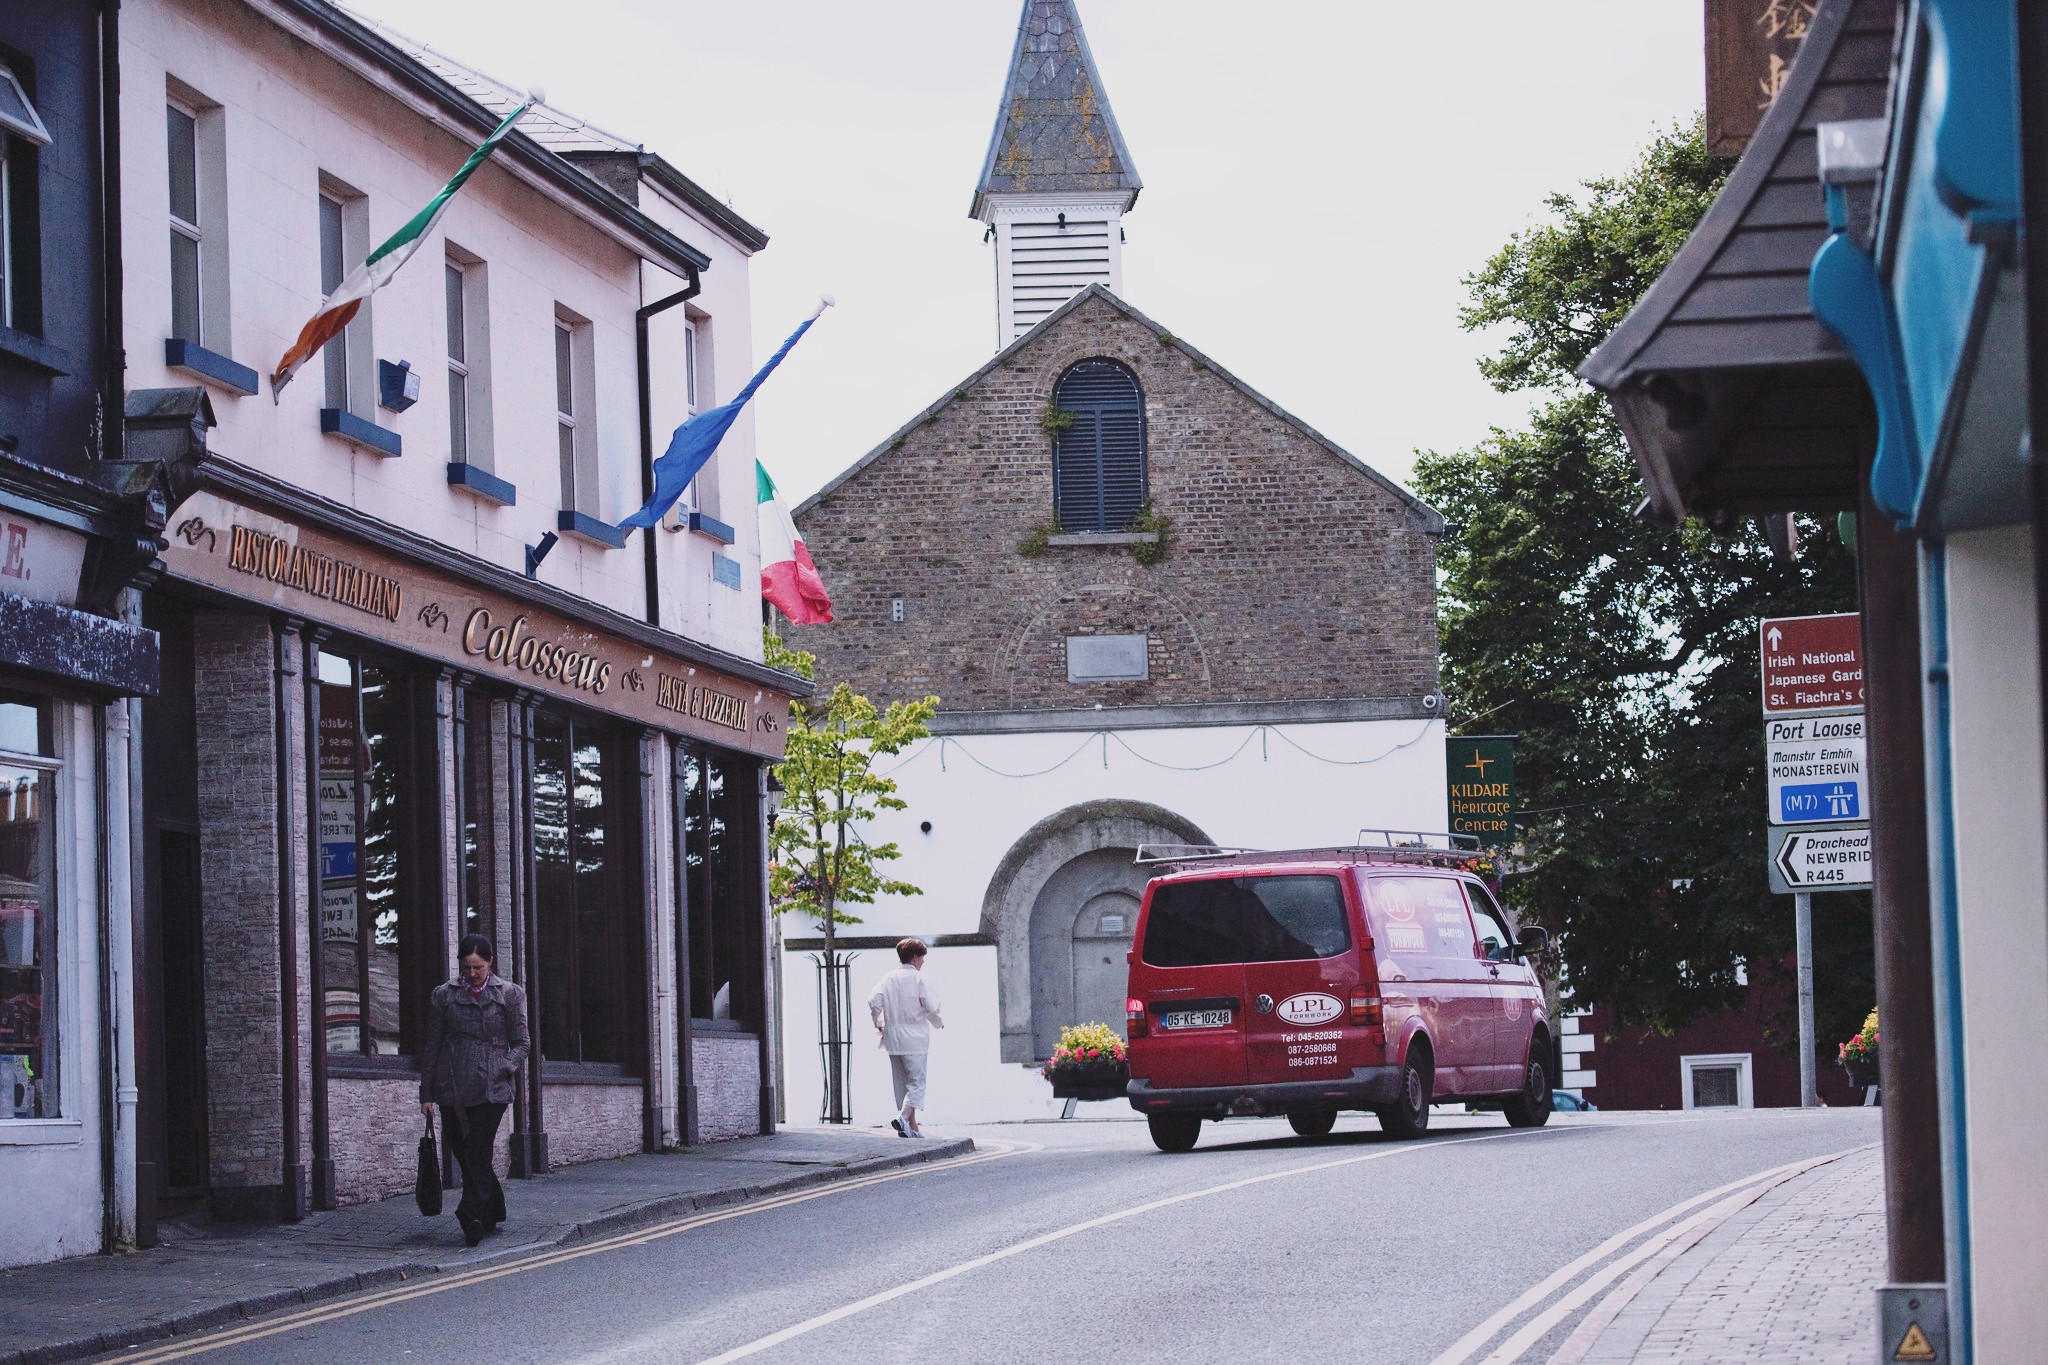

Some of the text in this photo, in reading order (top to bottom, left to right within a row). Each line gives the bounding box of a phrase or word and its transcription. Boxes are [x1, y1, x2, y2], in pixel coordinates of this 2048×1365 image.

[0, 522, 31, 581] E.
[229, 524, 333, 600] RISTORANTE
[331, 560, 403, 622] ITALIANO
[463, 607, 612, 694] Colosseus
[1768, 650, 1856, 667] Irish National
[1769, 673, 1826, 687] Japanese
[656, 673, 748, 732] PASTA & PIZZERIA
[1770, 693, 1789, 705] St.
[1795, 689, 1853, 704] Fiachra's
[1772, 721, 1862, 740] Port Laoise
[1772, 762, 1860, 778] MONASTEREVIN
[1451, 783, 1510, 797] KILDARE
[1806, 835, 1869, 849] Droichead
[1806, 869, 1844, 882] R445
[1289, 999, 1332, 1013] LPL
[1167, 1012, 1230, 1026] 05-KE-10248
[1281, 1031, 1343, 1042] Tel: 045-520362
[1287, 1043, 1337, 1055] 087-2580668
[1288, 1056, 1338, 1067] 086-0871524
